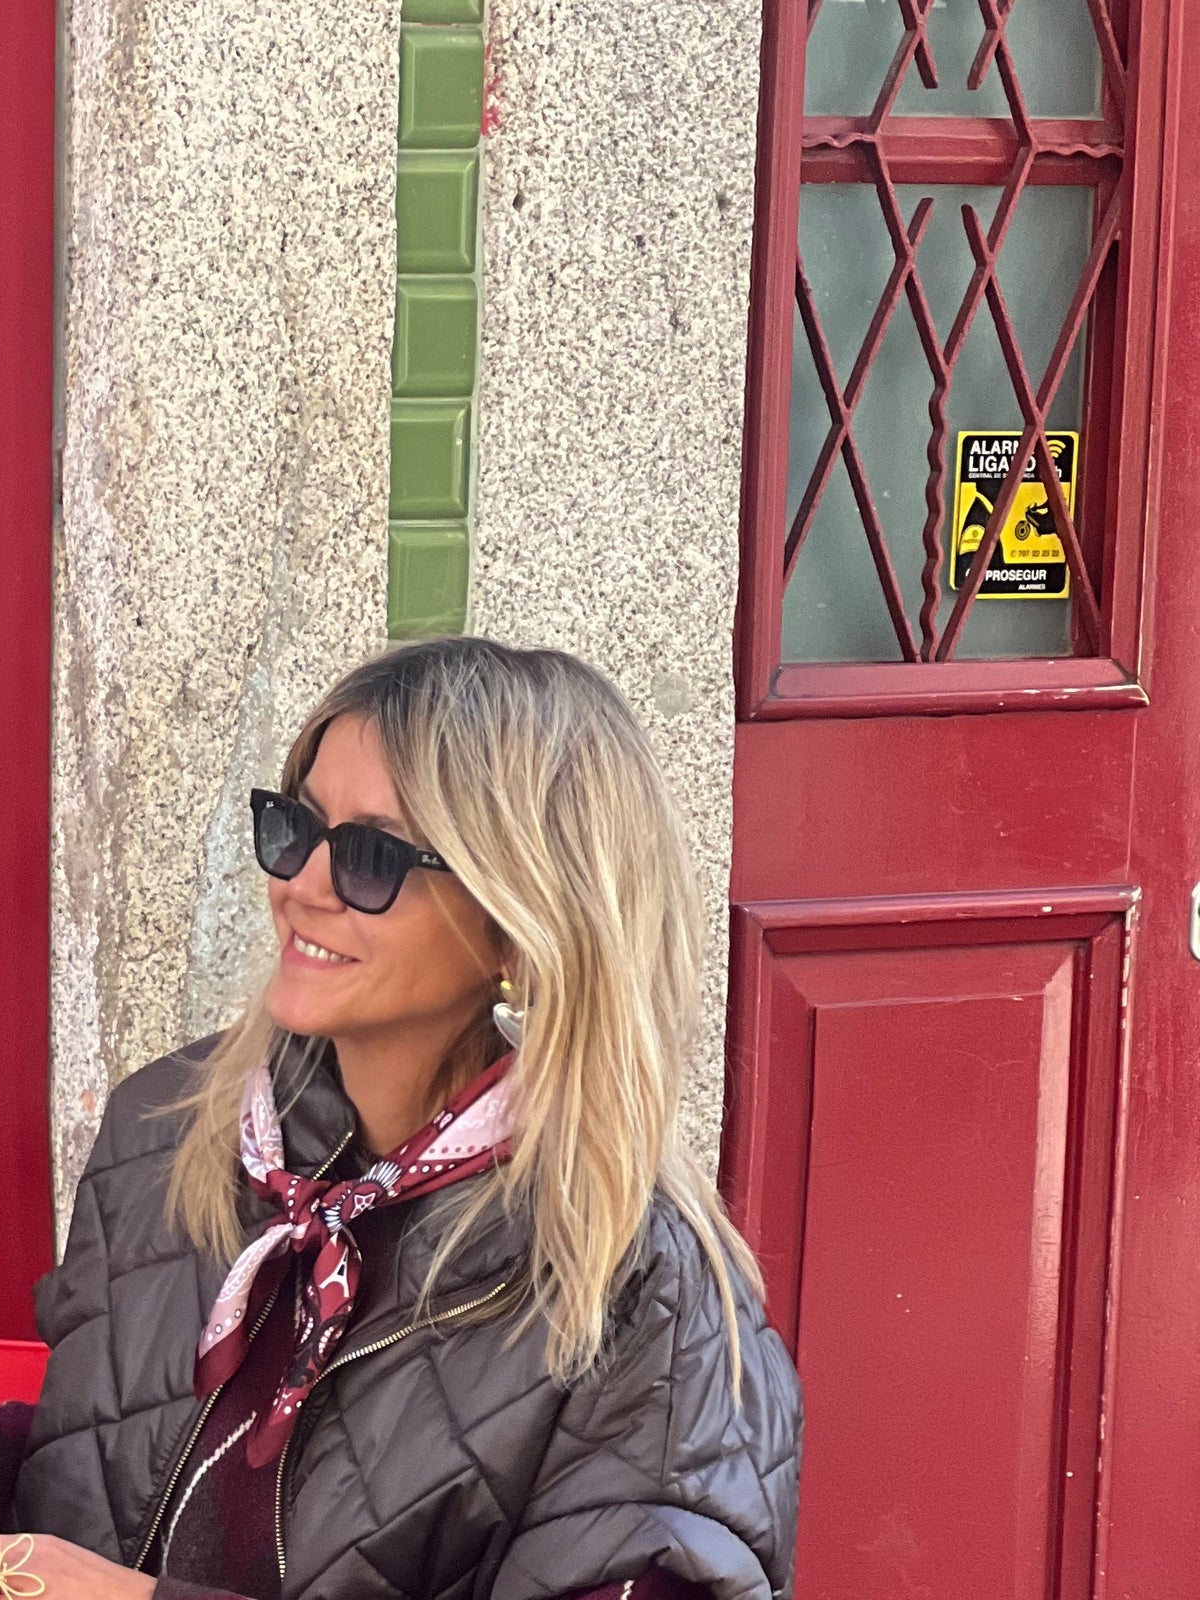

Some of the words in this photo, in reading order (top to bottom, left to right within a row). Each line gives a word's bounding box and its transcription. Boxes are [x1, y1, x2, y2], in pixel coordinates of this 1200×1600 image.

[970, 440, 1035, 455] ALAR
[968, 456, 1037, 473] LIGAO
[986, 569, 1047, 581] PROSEGUR
